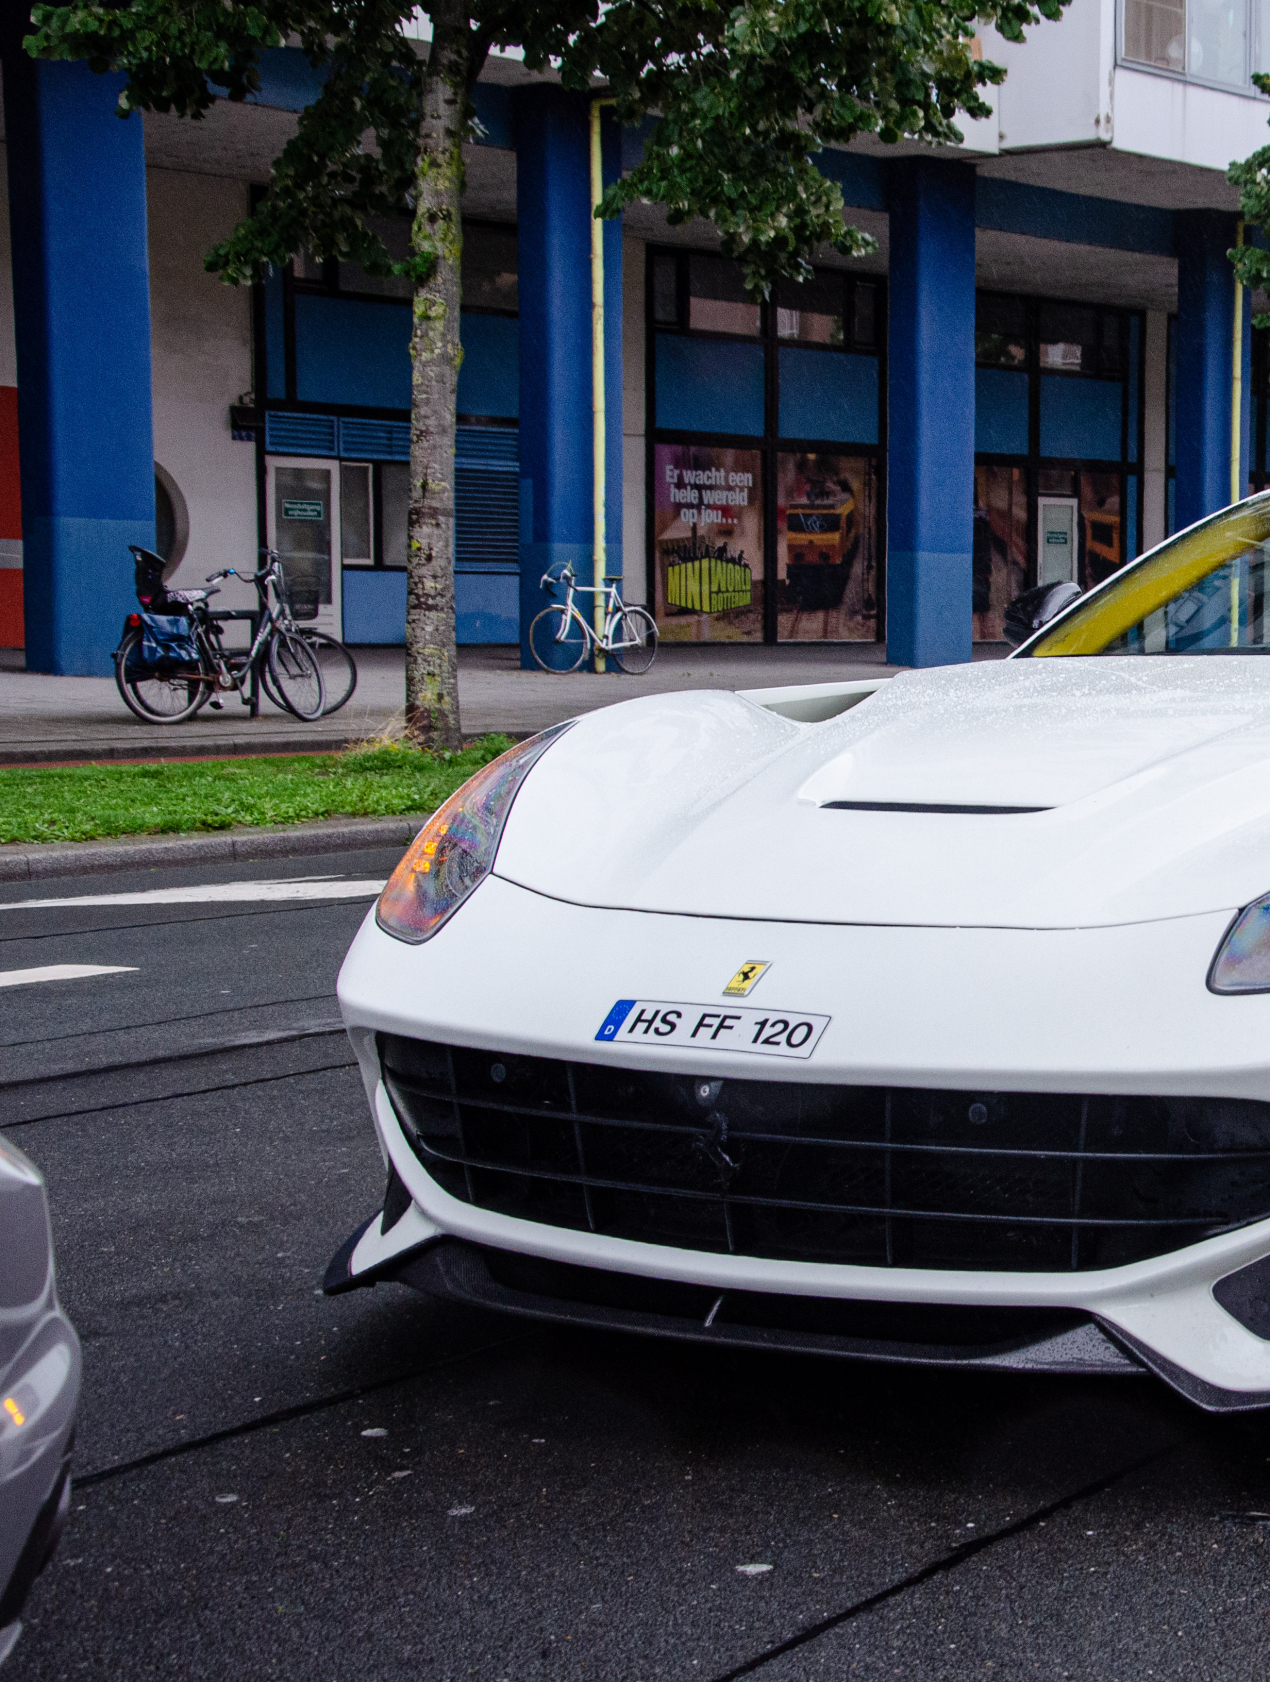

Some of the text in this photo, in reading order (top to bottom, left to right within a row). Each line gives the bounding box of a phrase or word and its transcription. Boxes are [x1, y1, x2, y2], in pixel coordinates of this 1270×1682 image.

[665, 465, 753, 487] Er wacht een
[670, 485, 748, 506] hele wereld
[680, 507, 738, 526] op jou...
[667, 557, 751, 613] MINI WORLD
[603, 1008, 814, 1049] D HS FF 120
